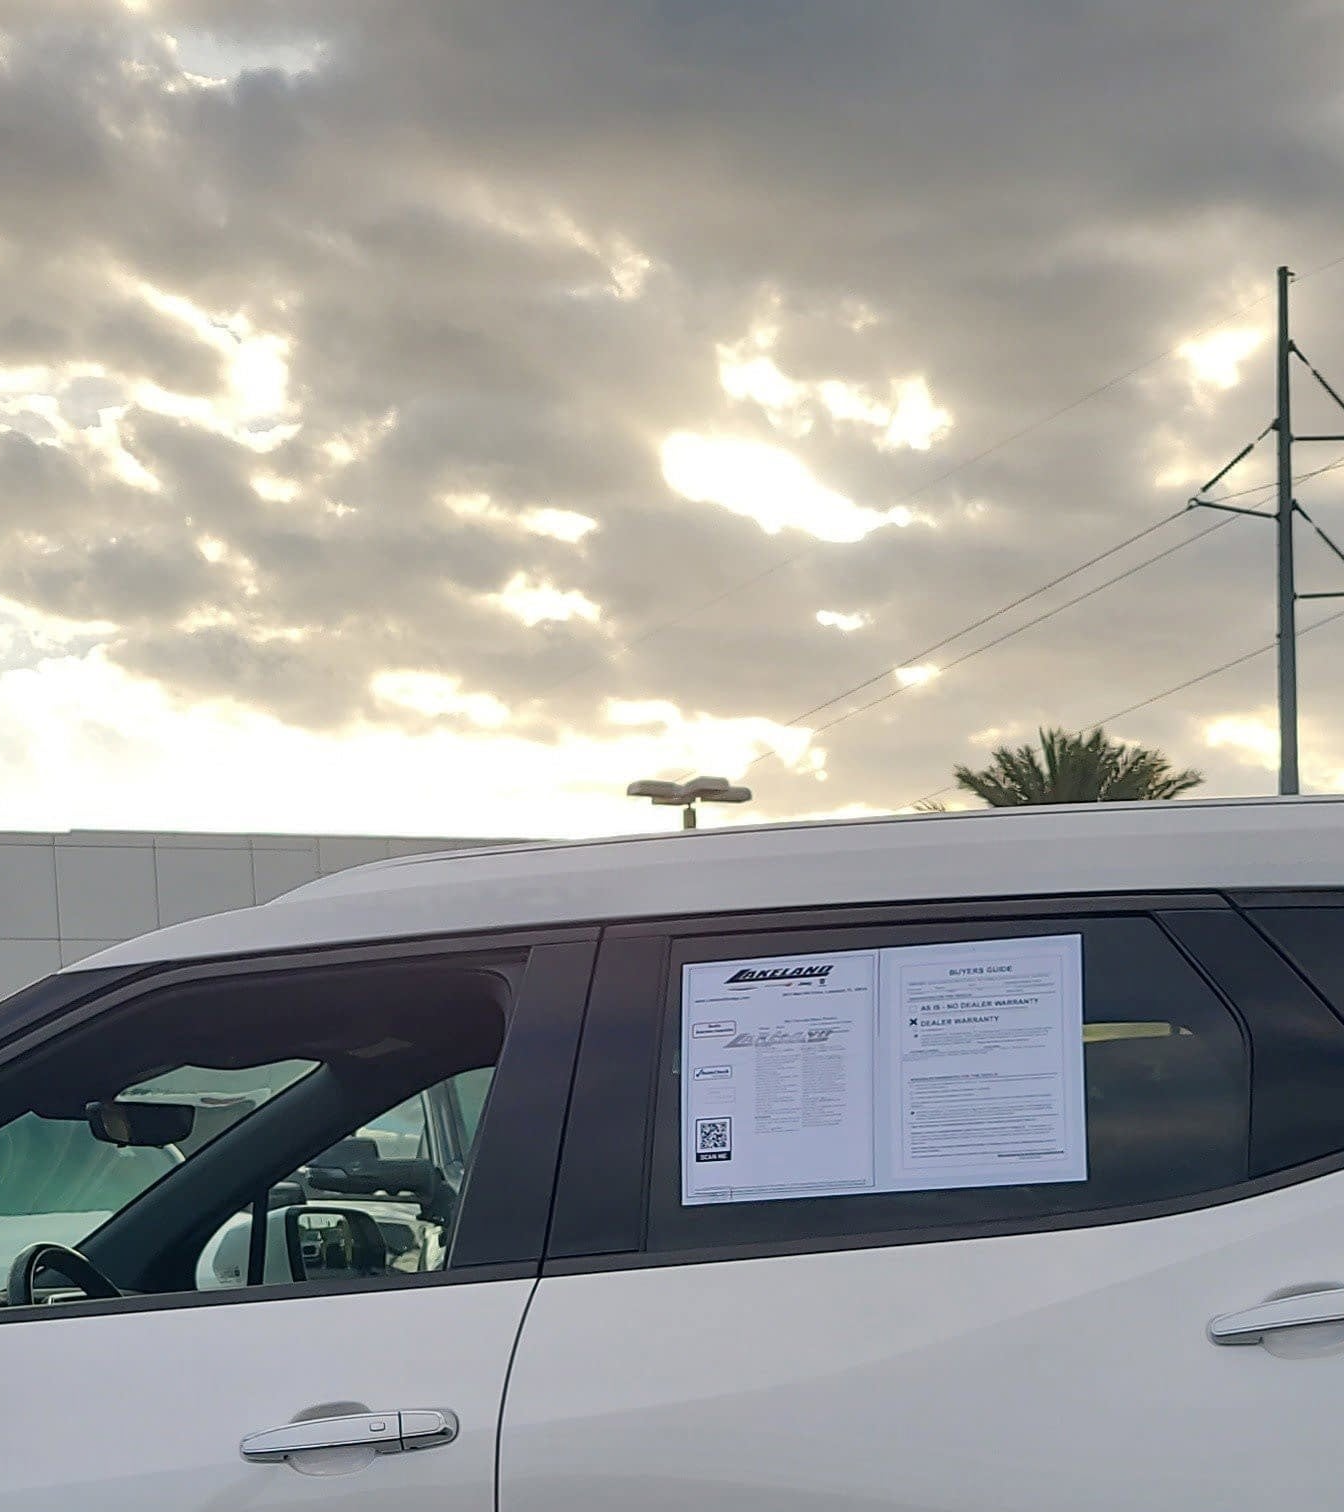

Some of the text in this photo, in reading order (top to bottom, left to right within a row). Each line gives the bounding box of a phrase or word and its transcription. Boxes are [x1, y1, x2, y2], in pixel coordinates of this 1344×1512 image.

[723, 965, 834, 984] LAKELAND
[949, 965, 1013, 976] BUYERS GUIDE
[960, 1001, 993, 1009] DEALER
[995, 998, 1038, 1006] WARRANTY
[920, 1016, 999, 1027] DEALER WARRANTY
